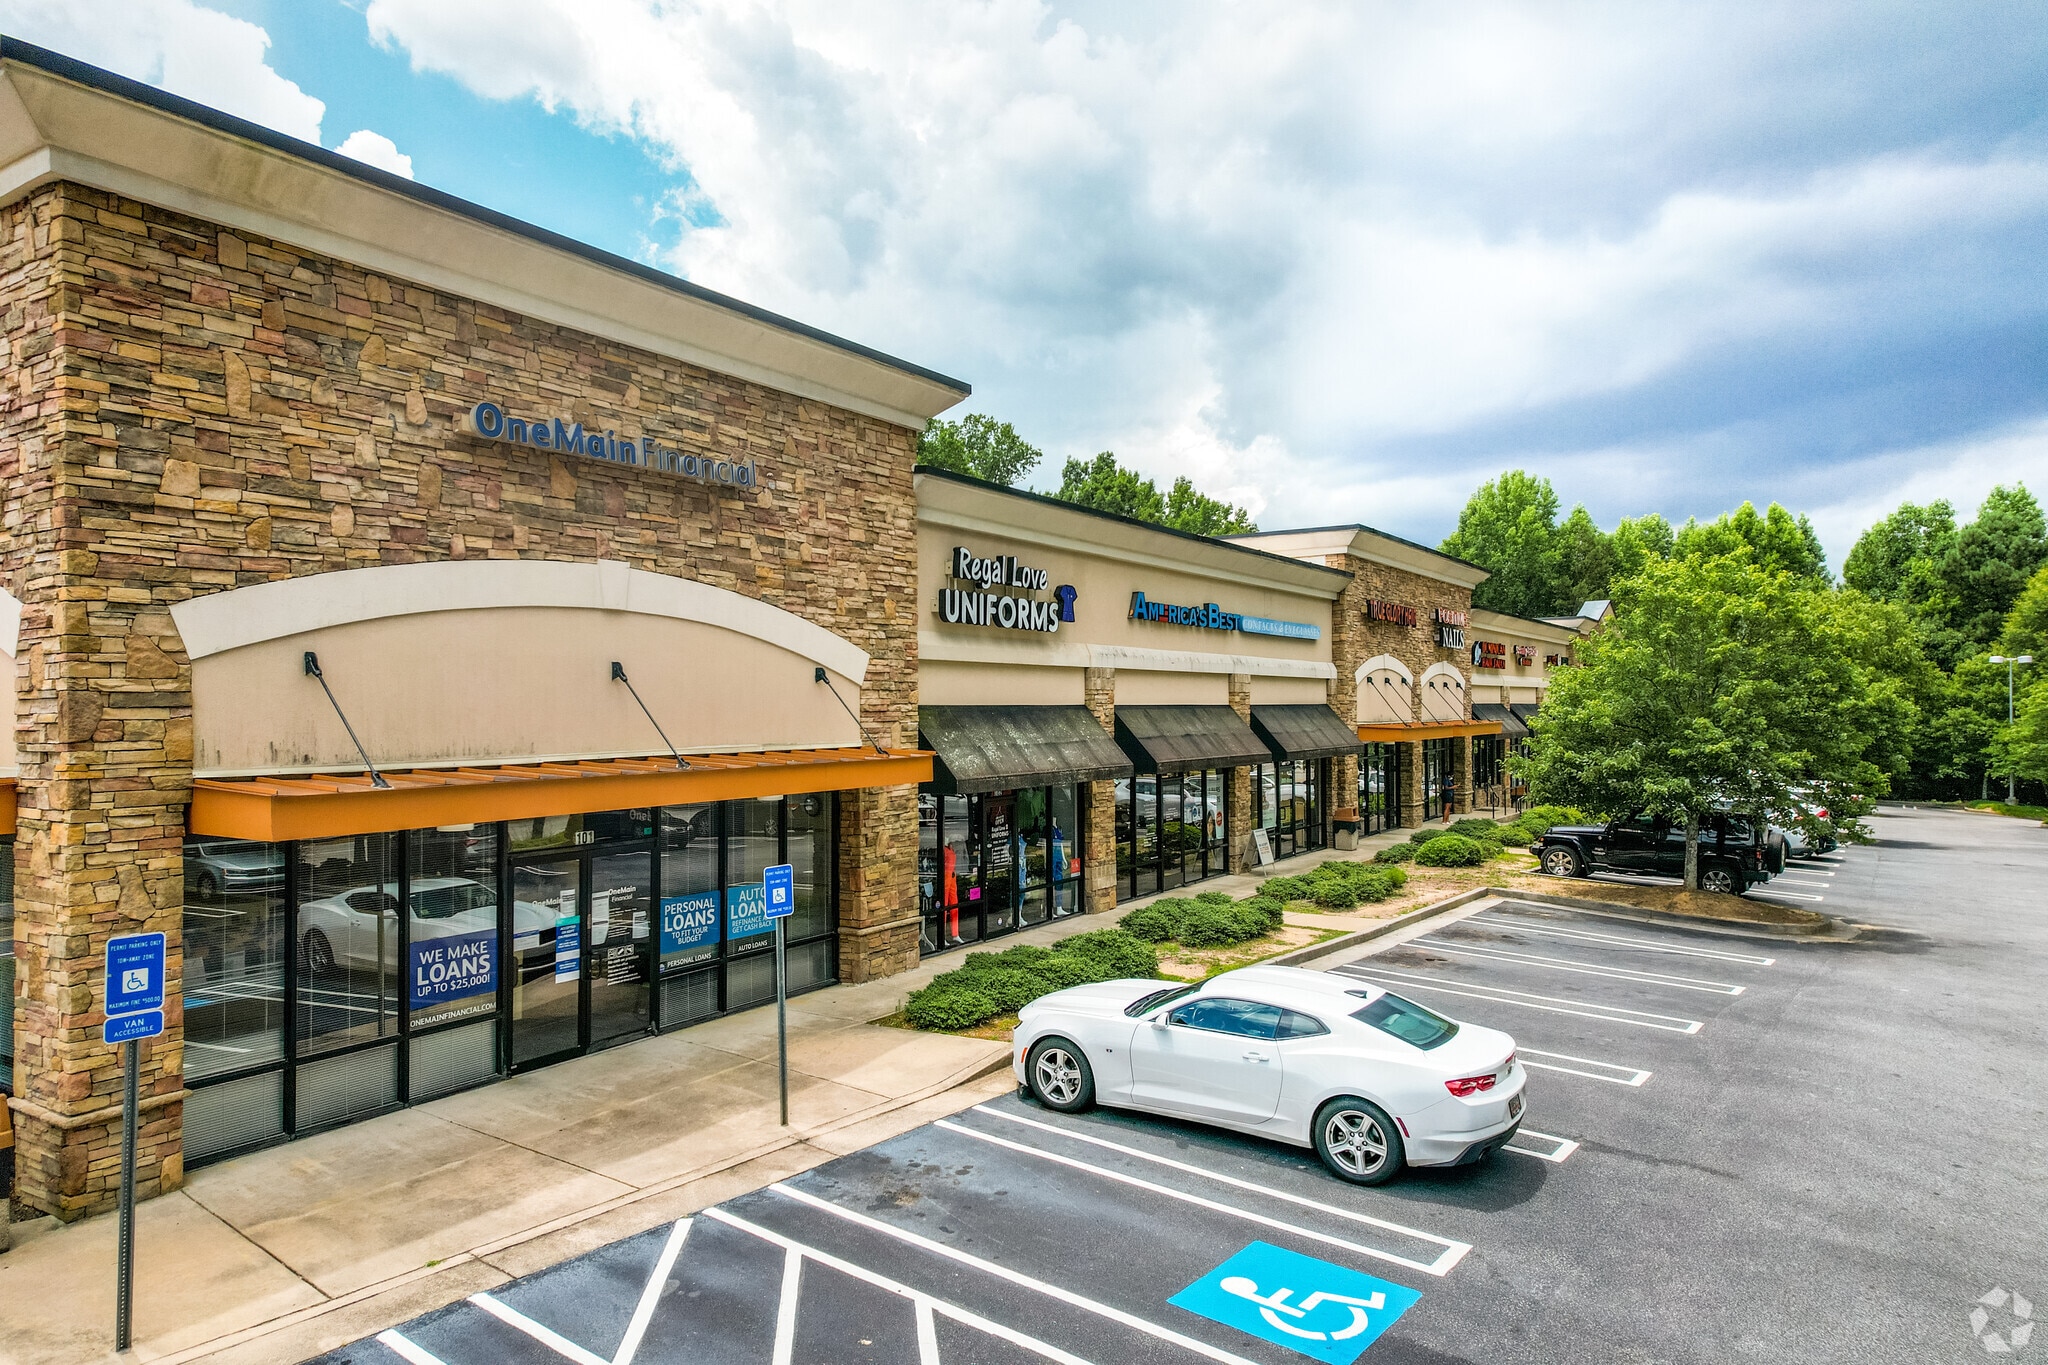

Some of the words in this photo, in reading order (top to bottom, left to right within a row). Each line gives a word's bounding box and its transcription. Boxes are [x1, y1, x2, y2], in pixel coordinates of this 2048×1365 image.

[957, 546, 1006, 589] Regal
[1011, 556, 1048, 590] Love
[943, 588, 1059, 633] UNIFORMS
[1442, 627, 1465, 649] NAILS
[664, 897, 715, 916] PERSONAL
[664, 908, 715, 932] LOANS
[732, 916, 762, 927] REFINANCE
[732, 925, 743, 934] GET
[743, 922, 758, 932] CASH
[758, 919, 773, 929] BACK
[672, 931, 680, 939] TO
[681, 929, 691, 937] FIT
[692, 926, 708, 935] YOUR
[678, 933, 702, 945] BUDGET
[110, 944, 127, 952] PERMIT
[128, 941, 148, 949] PARKING
[150, 939, 162, 947] ONLY
[419, 949, 443, 964] WE
[447, 940, 488, 960] MAKE
[738, 943, 751, 952] AUTO
[752, 940, 768, 949] LOANS
[117, 955, 141, 964] TOW-AWAY
[142, 953, 155, 961] ZONE
[667, 956, 694, 968] PERSONAL
[695, 952, 712, 961] LOANS
[417, 954, 491, 986] LOANS
[417, 985, 432, 997] UP
[434, 982, 448, 994] TO
[450, 973, 490, 991] $25,000!
[108, 1001, 129, 1009] MAXIMUM
[410, 1001, 496, 1028] ONEMAINFINANCIAL.COM
[124, 1018, 145, 1028] VAN
[113, 1024, 154, 1038] ACCESSIBLE
